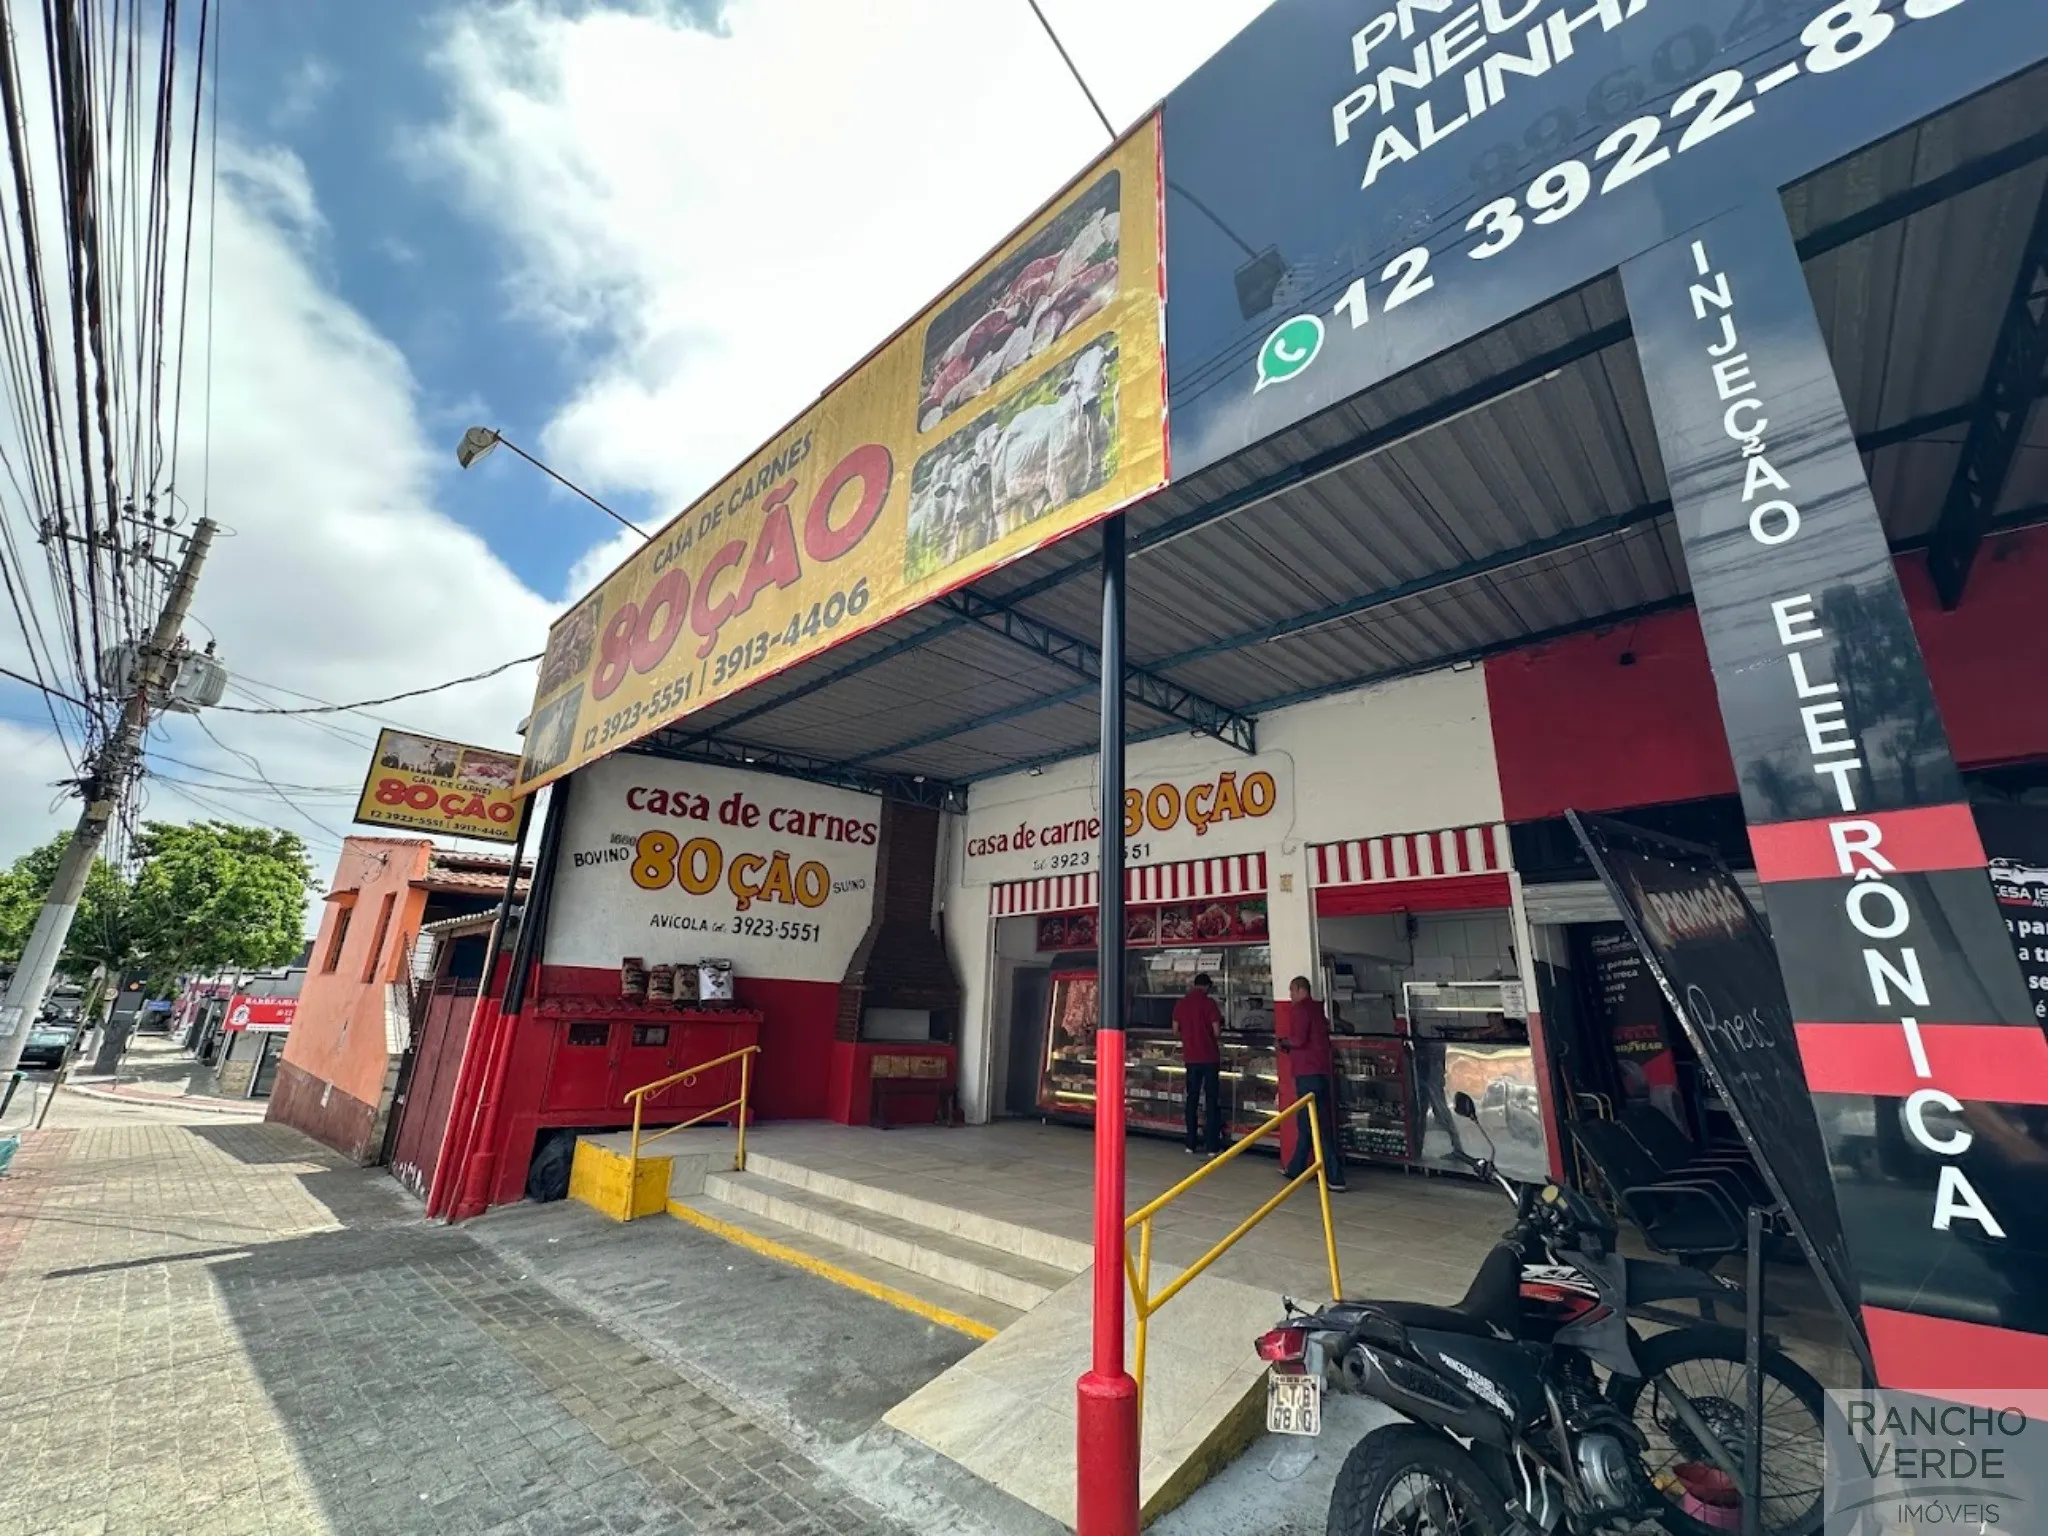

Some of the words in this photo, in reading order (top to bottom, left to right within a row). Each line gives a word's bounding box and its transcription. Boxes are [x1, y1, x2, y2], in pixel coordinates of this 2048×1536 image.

[1334, 246, 1435, 330] 12
[653, 528, 693, 574] CASA
[699, 505, 723, 541] DE
[728, 429, 813, 517] CARNES
[582, 723, 599, 753] 12
[599, 672, 693, 744] 3923-5551
[712, 577, 870, 687] 3913-4406
[1689, 240, 1800, 545] INJEÇÃO
[1771, 593, 2007, 1239] ELETRÔNICA
[412, 775, 437, 786] CASA
[440, 780, 453, 789] DE
[370, 809, 382, 819] 12
[386, 811, 444, 828] 3923-5551
[453, 822, 510, 837] 3913-4406
[626, 786, 710, 822] casa
[719, 792, 761, 829] de
[769, 806, 879, 847] carnes
[967, 833, 1009, 858] casa
[1013, 820, 1036, 851] de
[1040, 816, 1101, 847] carne
[574, 847, 630, 868] BOVINO
